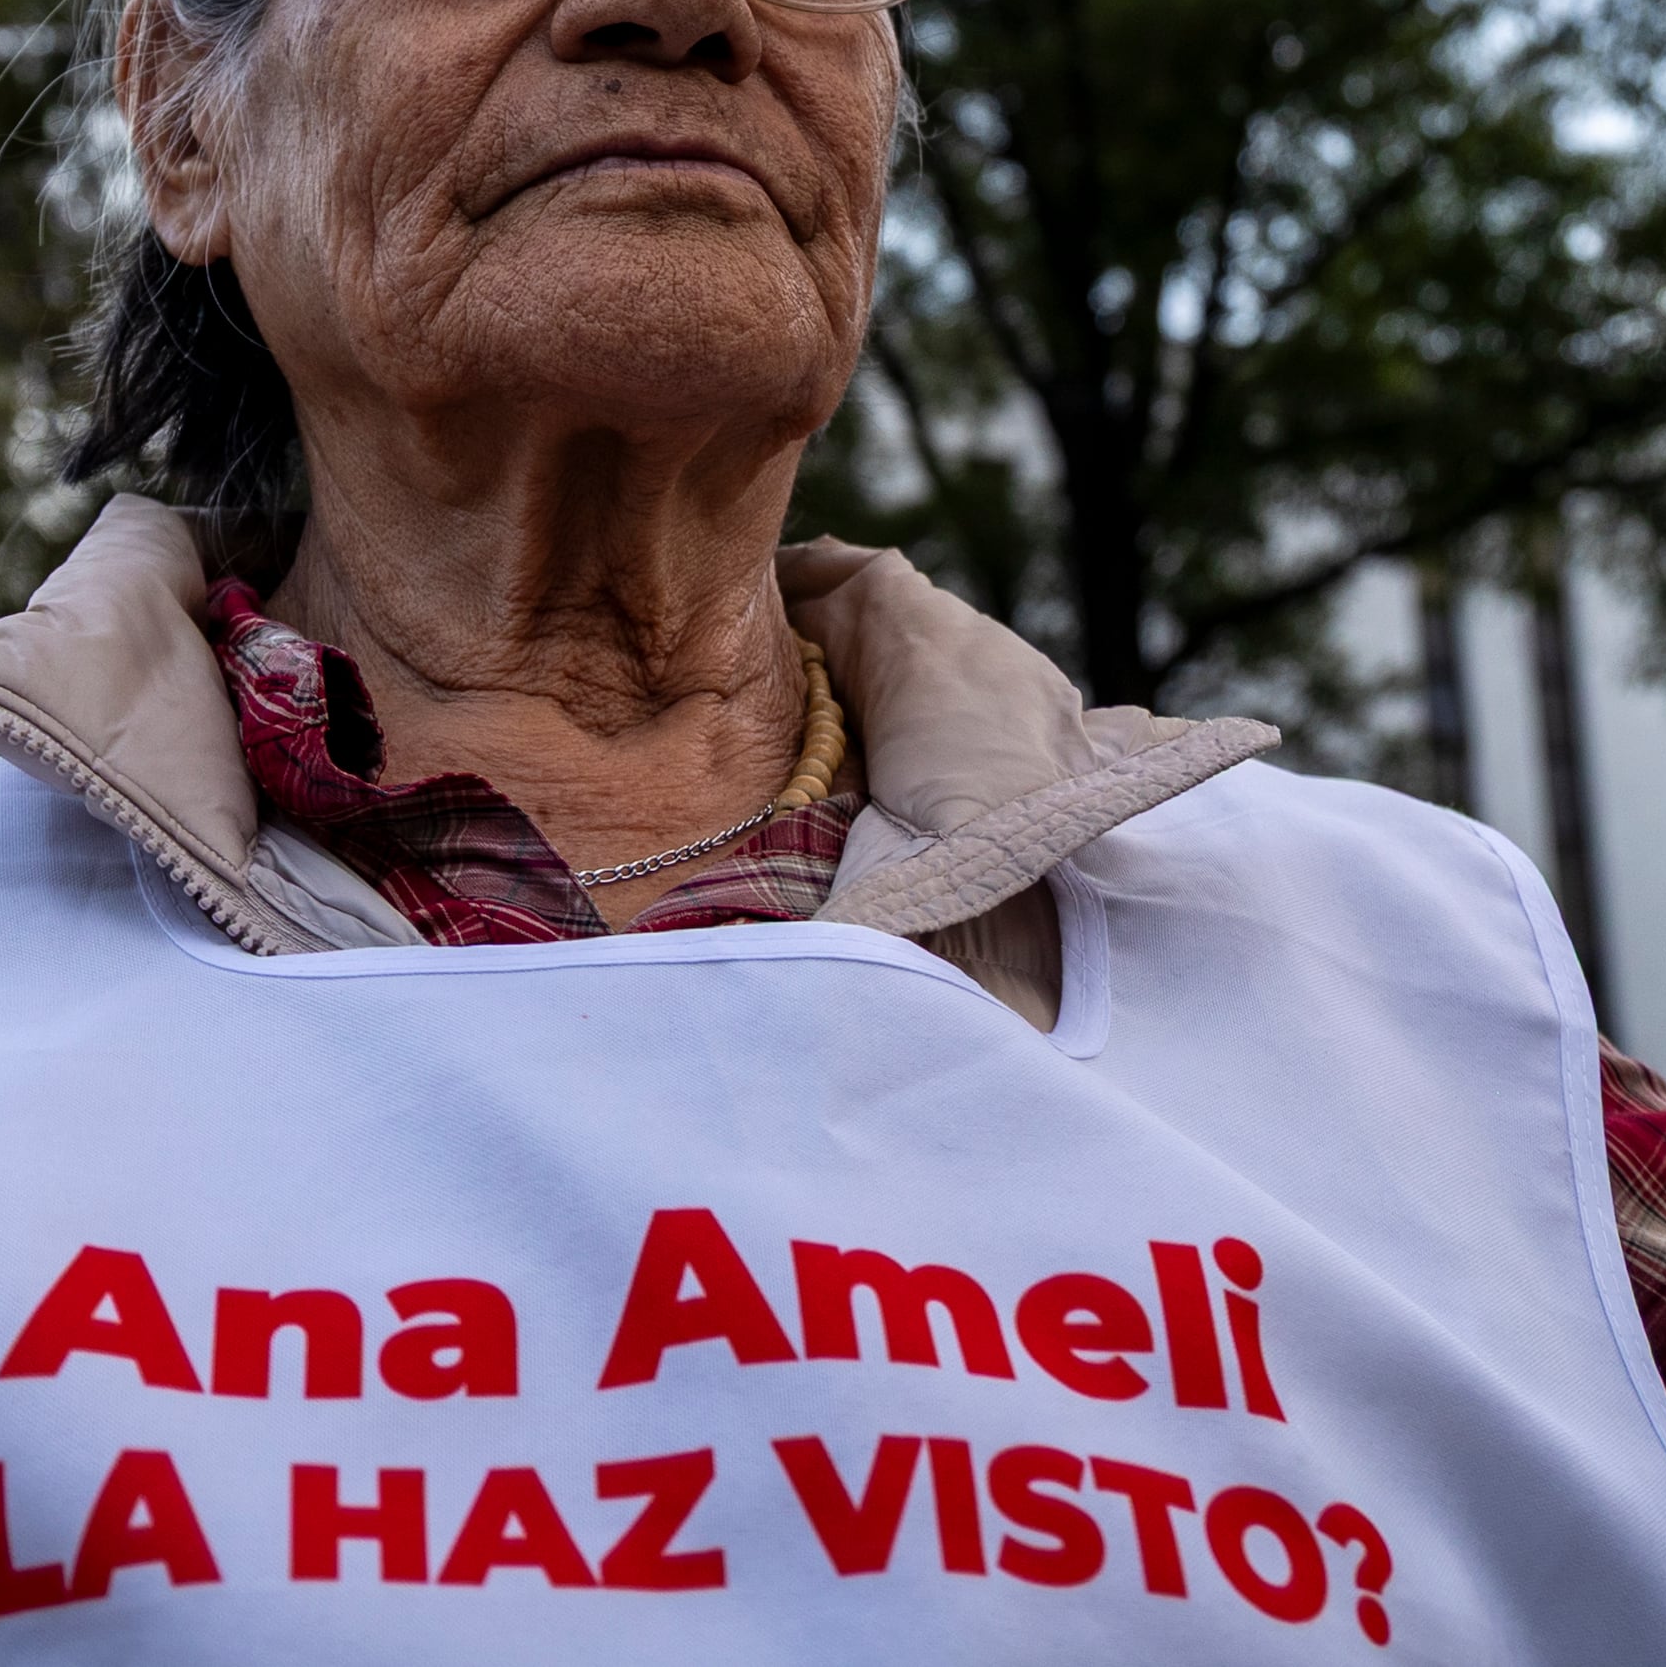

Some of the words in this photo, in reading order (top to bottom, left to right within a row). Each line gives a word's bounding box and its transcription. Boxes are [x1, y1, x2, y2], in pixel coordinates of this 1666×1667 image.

[597, 1207, 1286, 1423] Ameli
[289, 1448, 726, 1592] HAZ
[771, 1434, 1393, 1646] VISTO?
